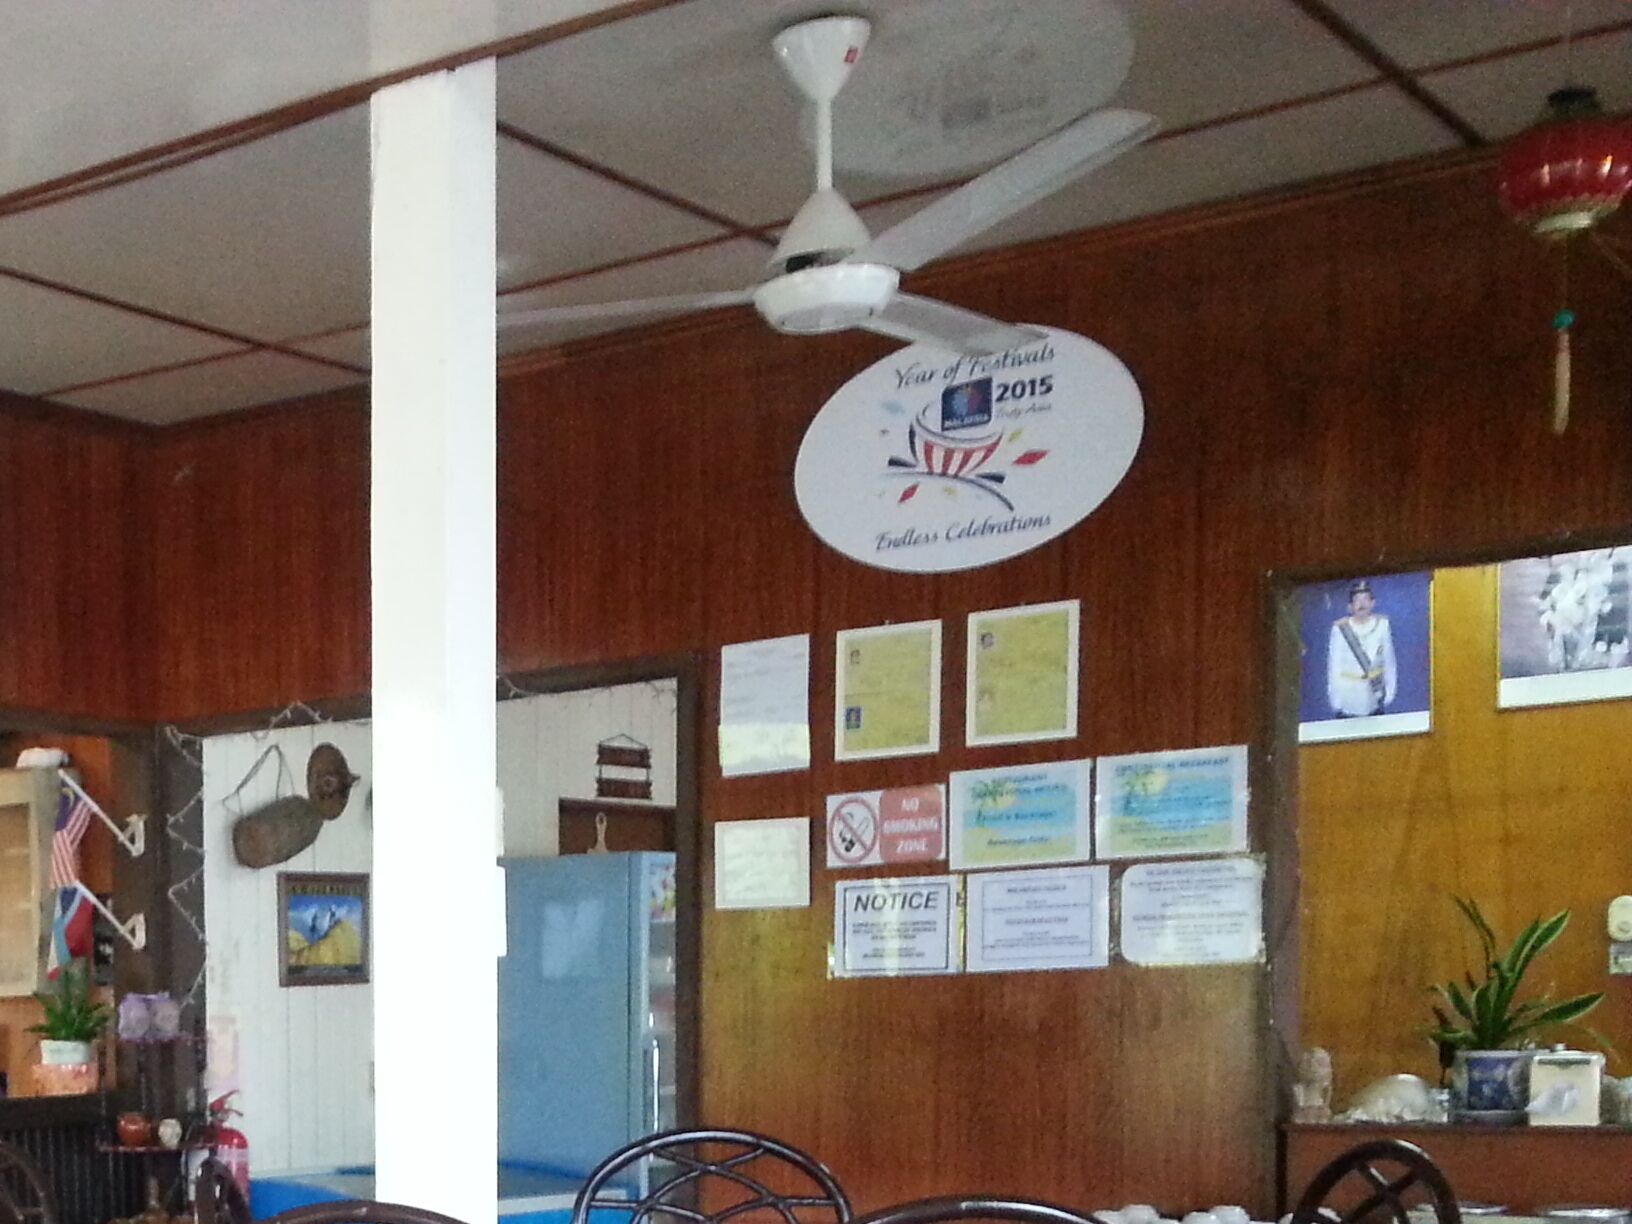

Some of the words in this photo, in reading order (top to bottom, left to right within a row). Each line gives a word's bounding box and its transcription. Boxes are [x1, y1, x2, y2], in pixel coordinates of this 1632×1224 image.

[896, 362, 937, 389] Year
[943, 358, 963, 383] of
[965, 343, 1056, 376] Festivals
[995, 375, 1054, 402] 2015
[875, 528, 938, 551] Endless
[945, 514, 1051, 543] Celebrations
[901, 797, 920, 813] NO
[853, 891, 940, 912] NOTICE
